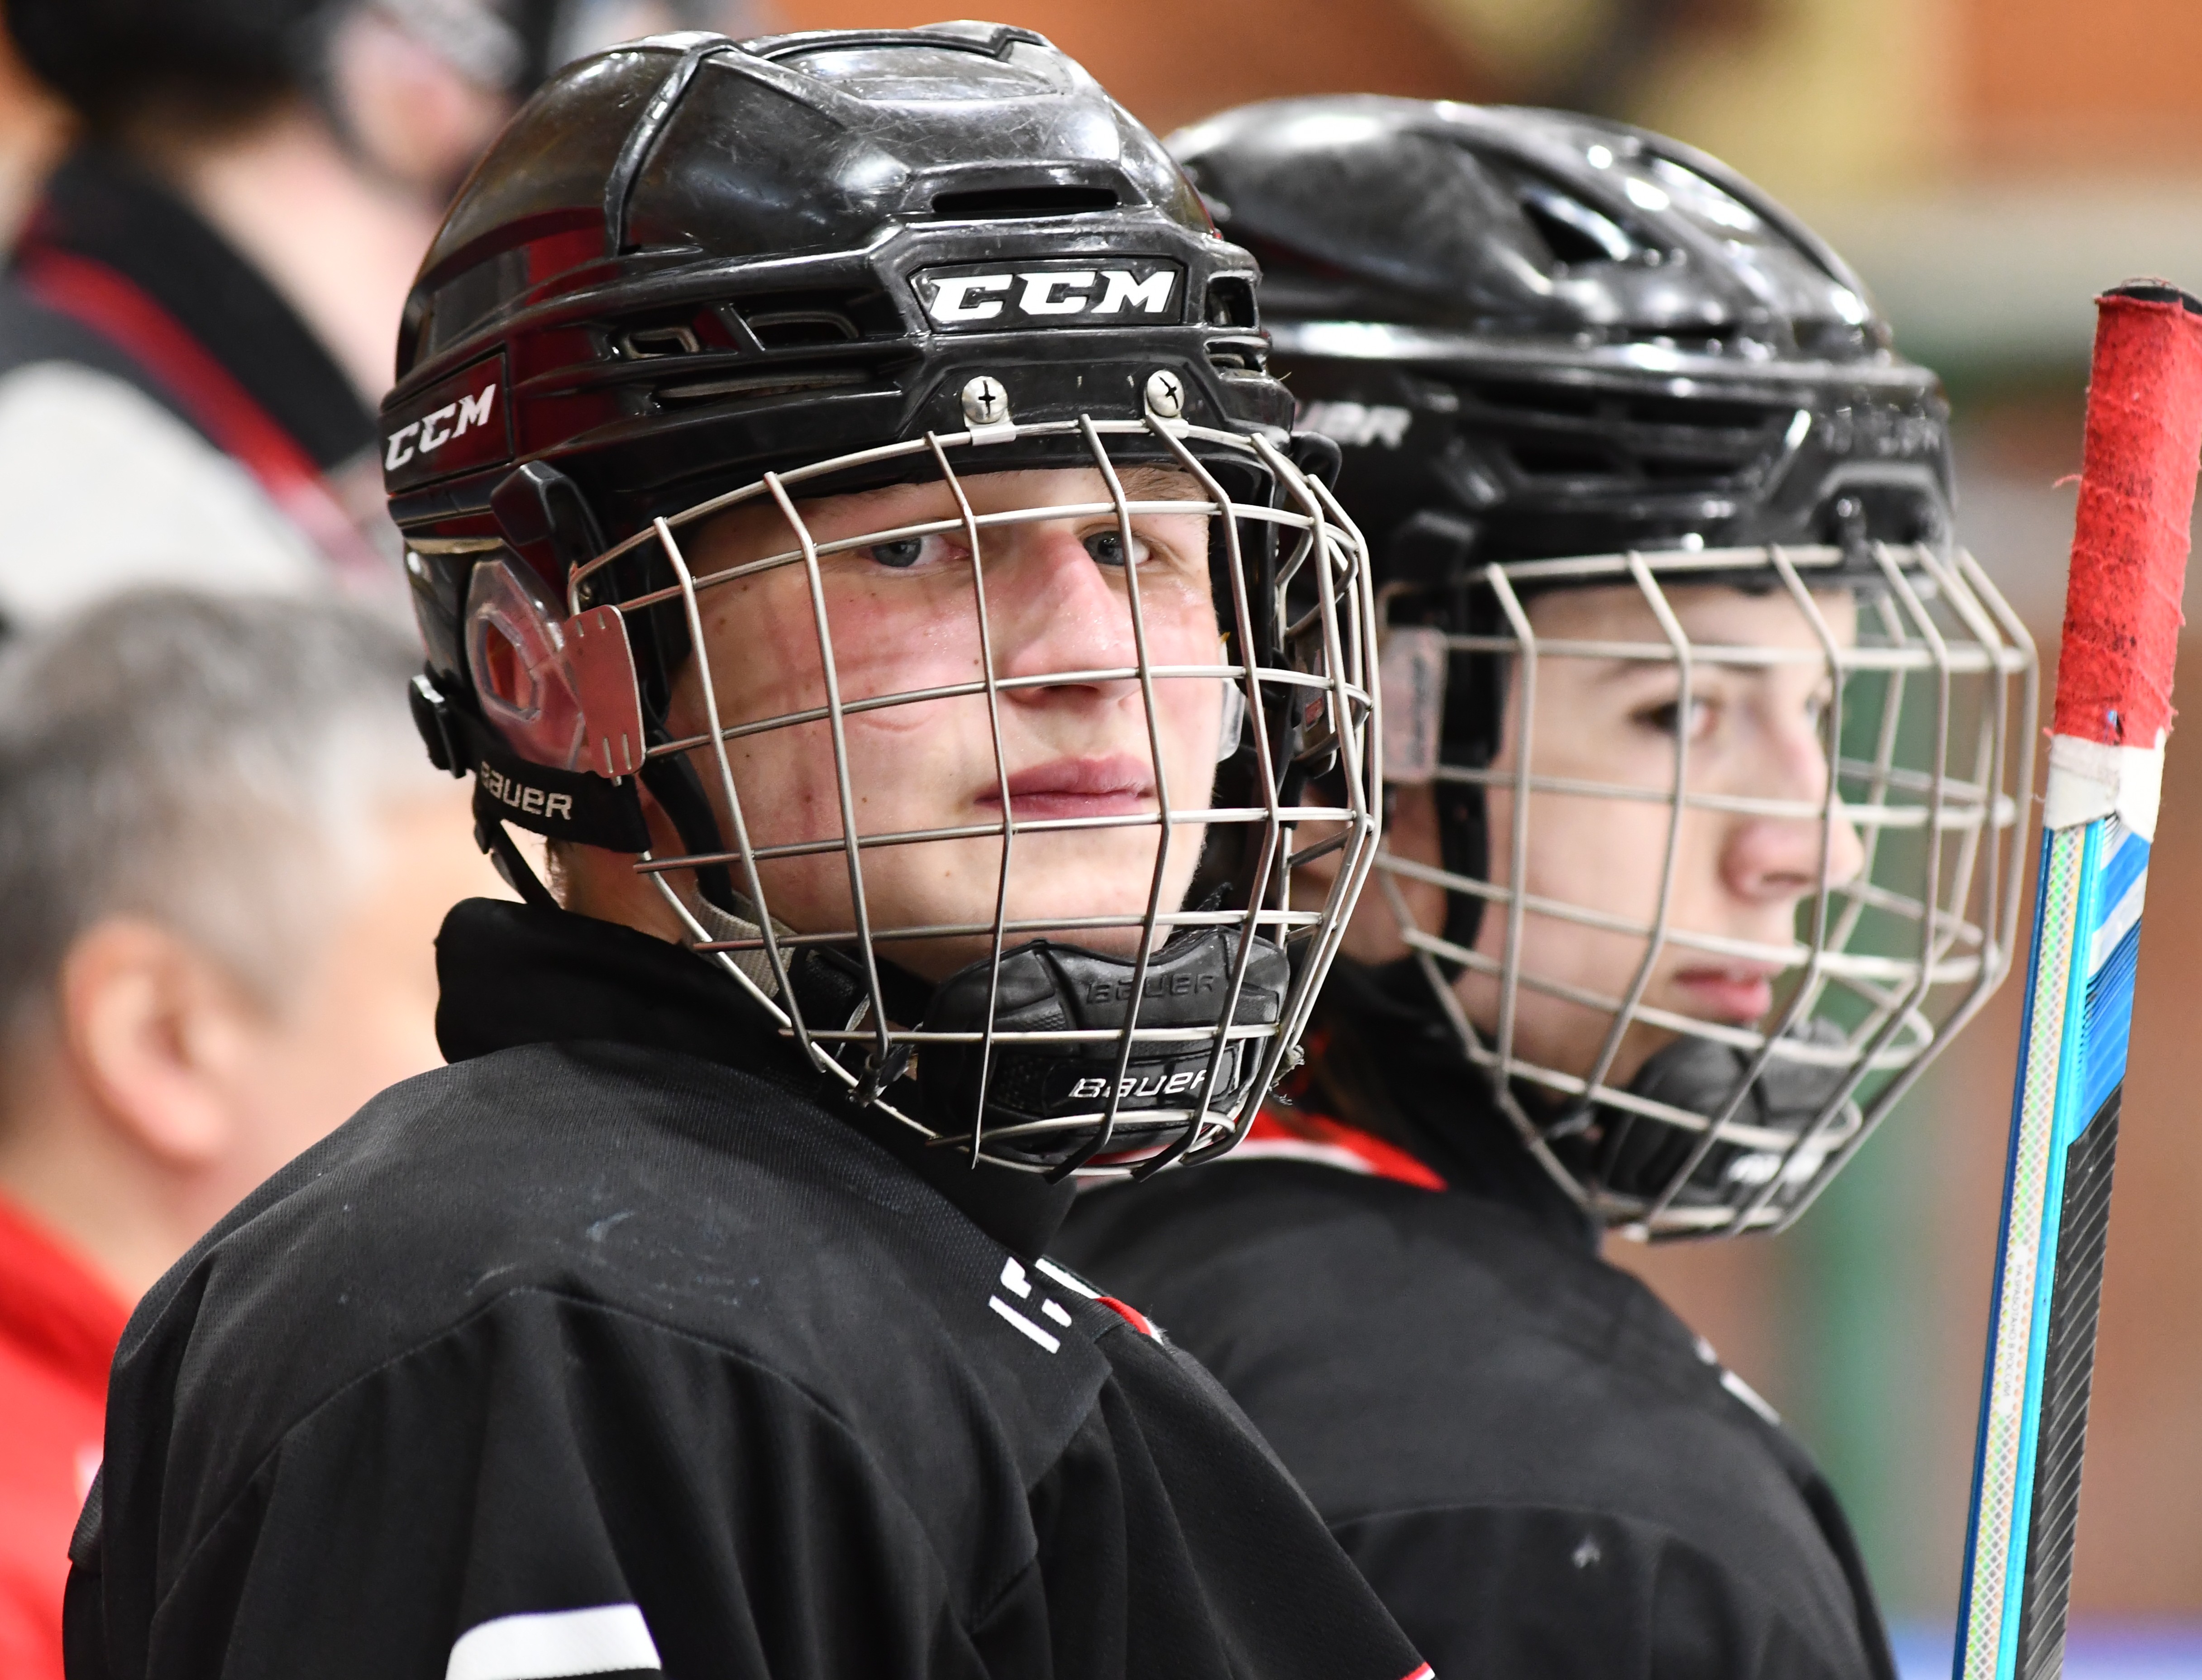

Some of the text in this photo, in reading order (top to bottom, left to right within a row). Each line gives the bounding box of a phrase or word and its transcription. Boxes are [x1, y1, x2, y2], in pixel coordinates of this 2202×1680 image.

[929, 271, 1175, 322] CCM
[385, 384, 496, 471] CCM
[2003, 1352, 2015, 1397] РОССИИ
